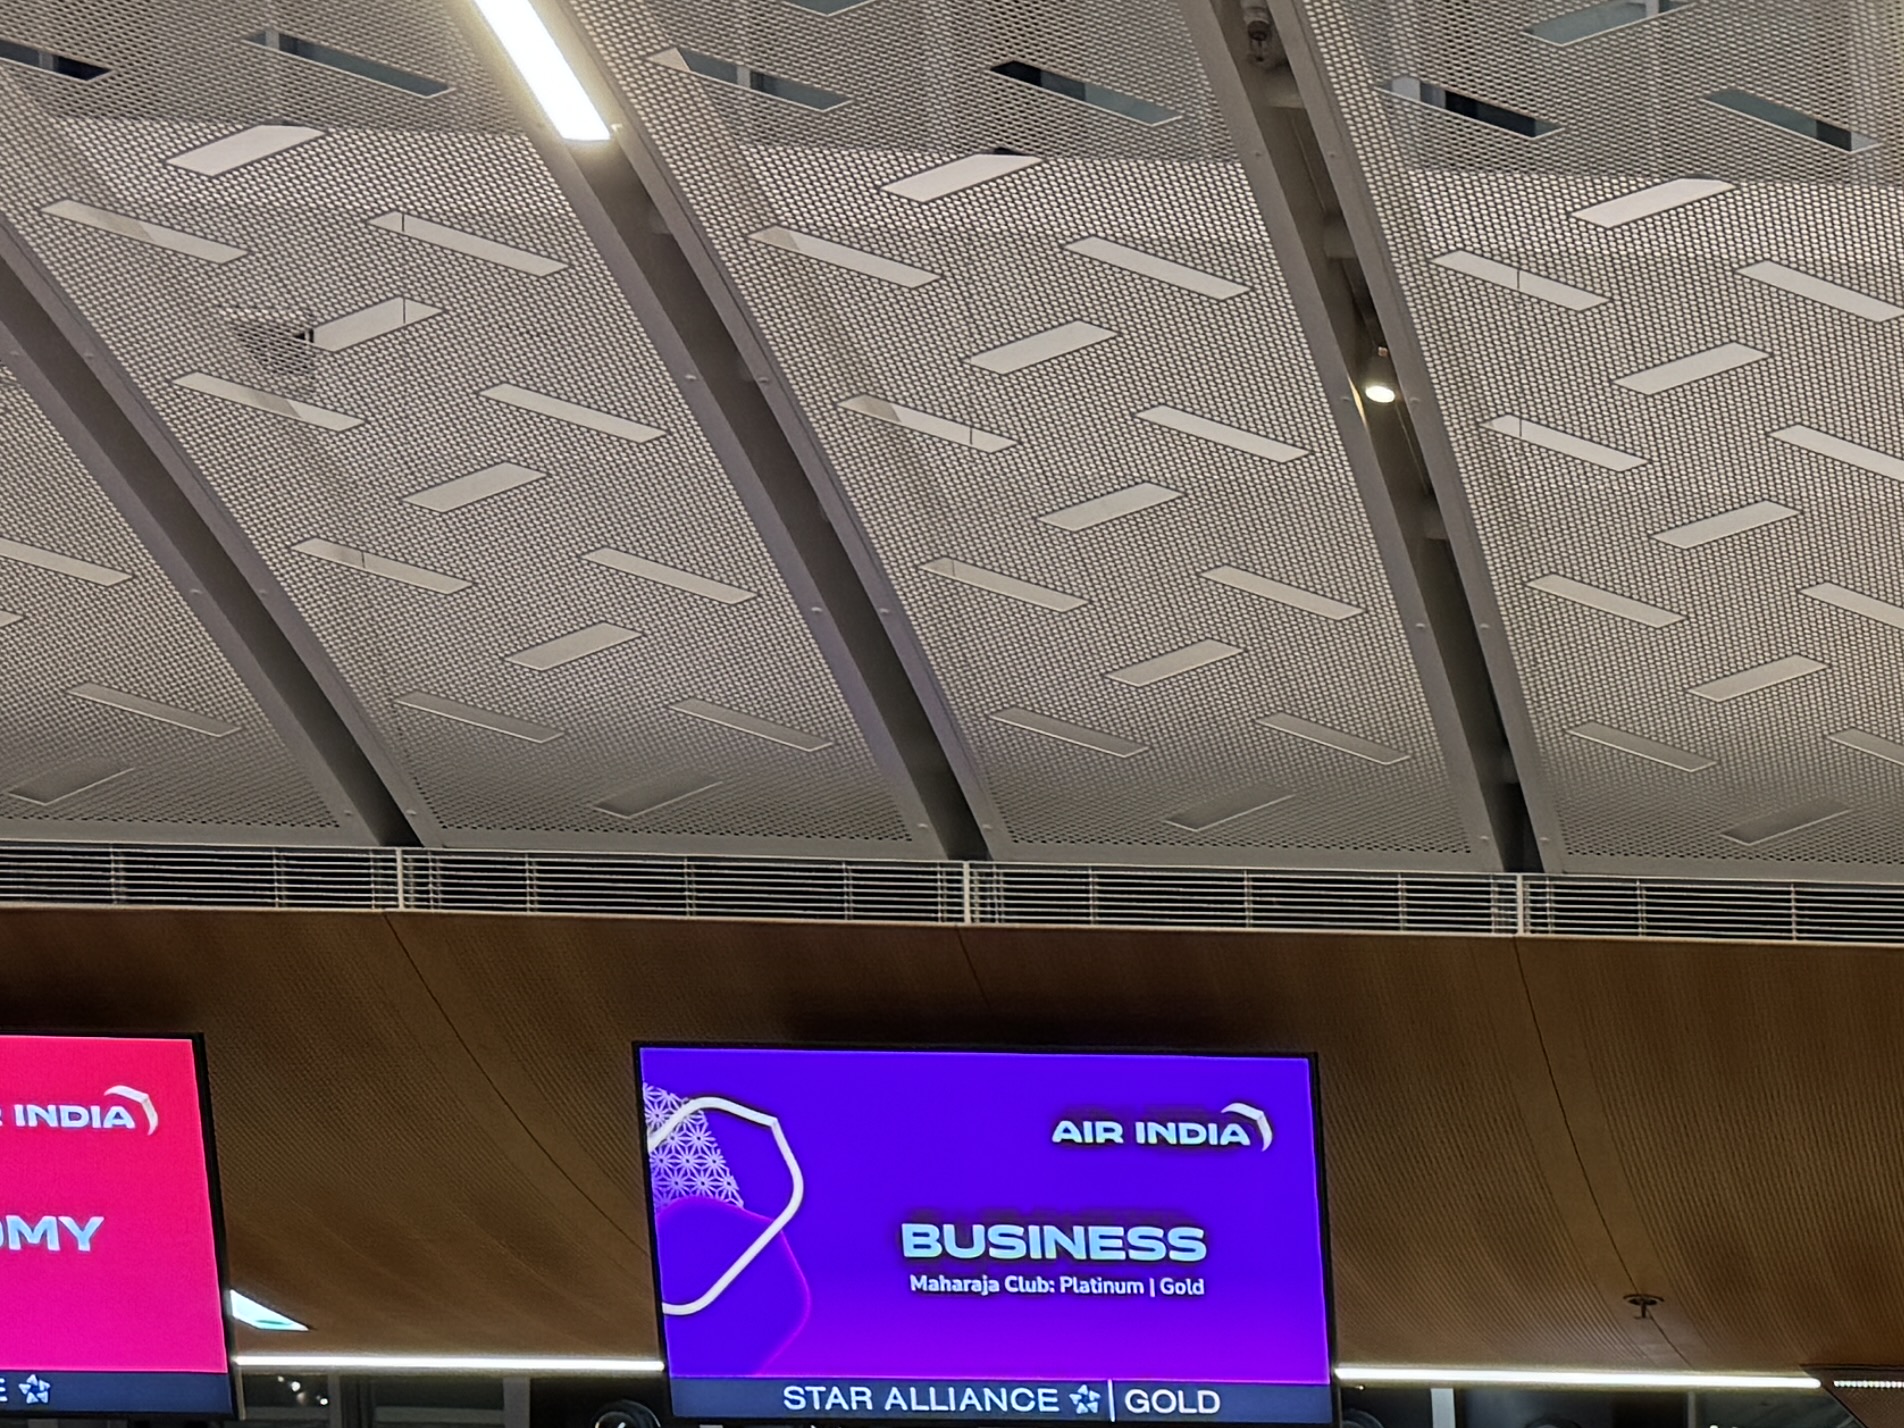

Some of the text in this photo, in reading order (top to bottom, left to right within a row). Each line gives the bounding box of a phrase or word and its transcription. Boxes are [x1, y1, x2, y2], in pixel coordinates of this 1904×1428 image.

[14, 1104, 136, 1129] INDIA
[1052, 1119, 1251, 1146] AIR INDIA
[0, 1214, 105, 1252] MY
[901, 1222, 1208, 1262] BUSINESS
[909, 1274, 1205, 1297] Maharaja Club: Platinum Gold
[783, 1385, 1222, 1415] STAR ALLIANCE GOLD
